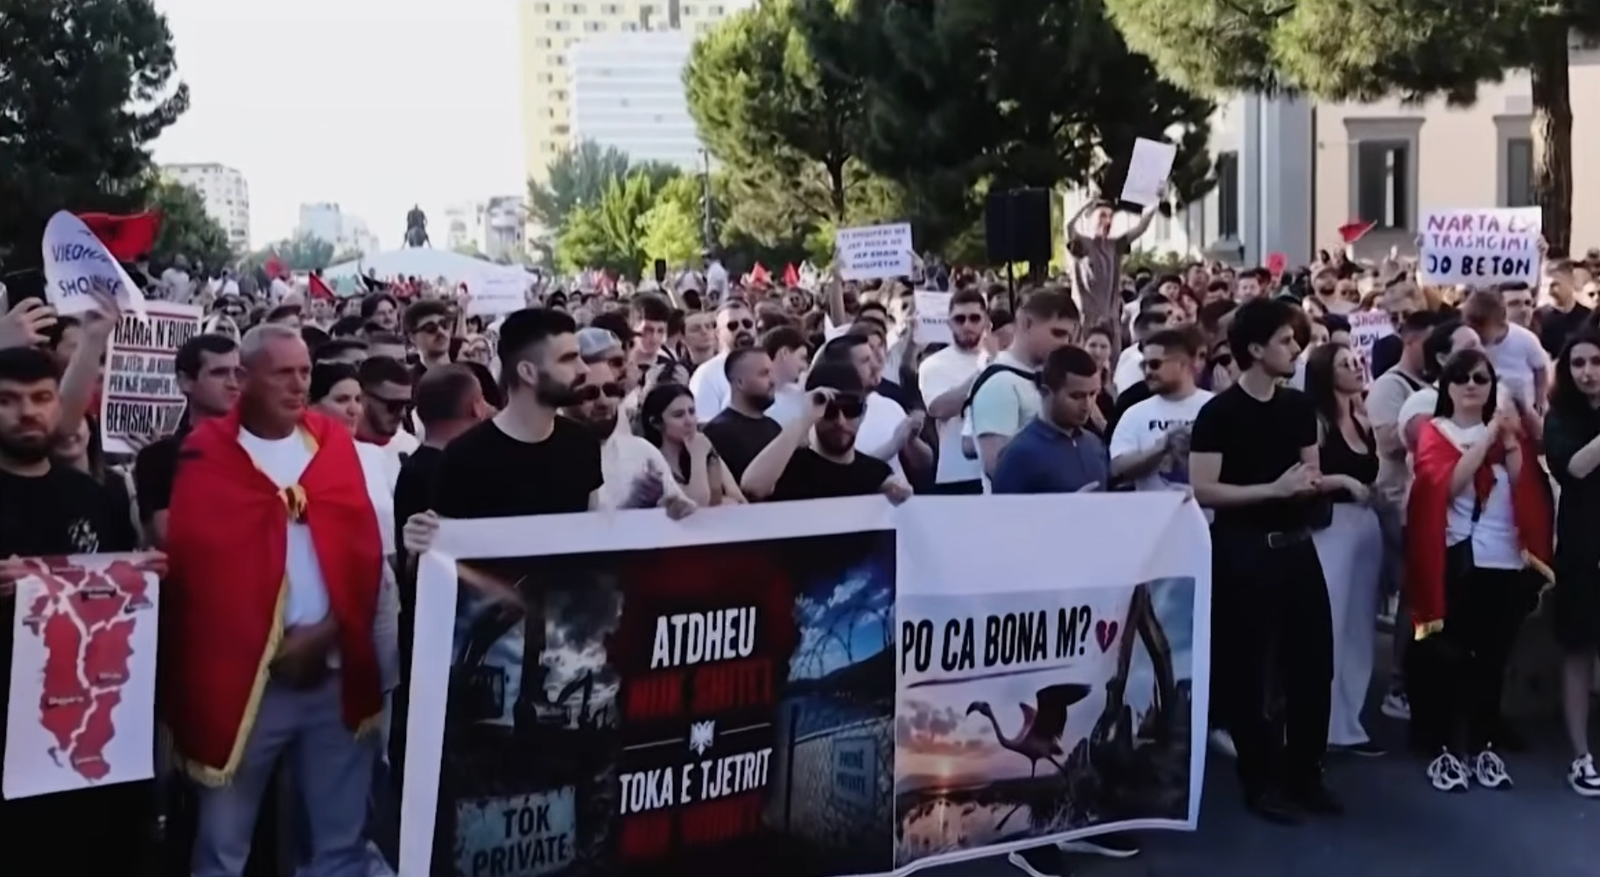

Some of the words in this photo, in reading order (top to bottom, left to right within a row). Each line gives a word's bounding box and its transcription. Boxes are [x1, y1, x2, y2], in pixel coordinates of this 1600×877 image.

[1427, 214, 1500, 233] NARTA
[1427, 254, 1452, 275] JO
[1461, 255, 1530, 276] BETON
[106, 402, 154, 434] BERISHA
[650, 606, 757, 670] ATDHEU
[902, 619, 934, 676] PO
[941, 617, 976, 672] CA
[984, 610, 1048, 668] BONA
[1055, 604, 1092, 659] M?
[619, 766, 674, 815] TOKA
[680, 763, 695, 804] E
[700, 747, 773, 801] TJETRIT
[472, 832, 569, 877] PRIVATE
